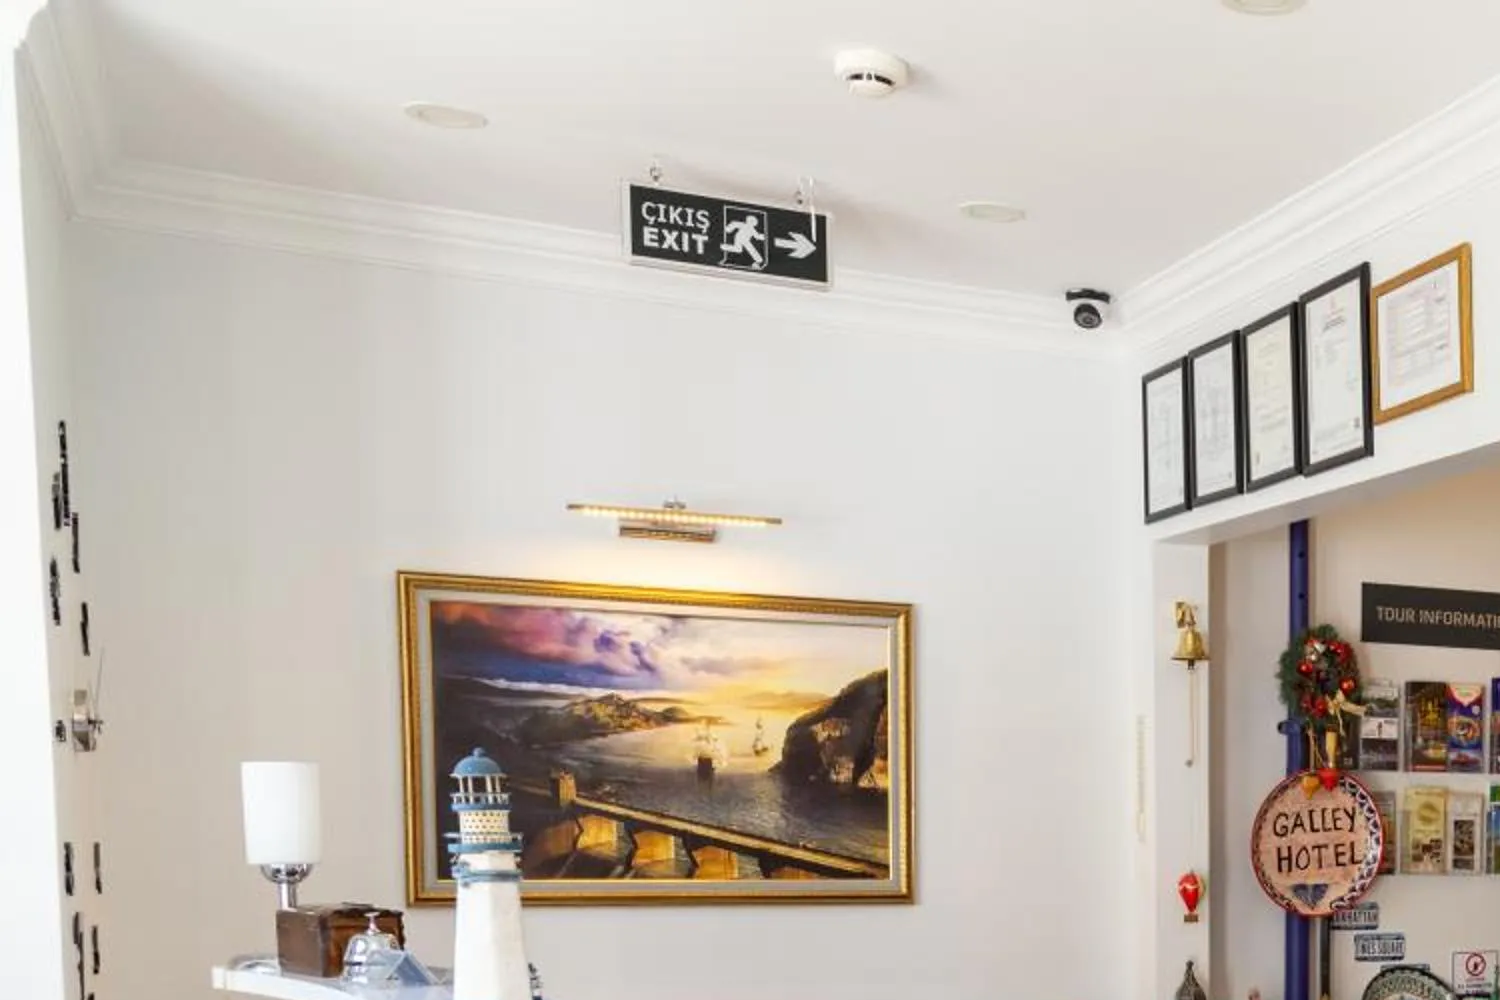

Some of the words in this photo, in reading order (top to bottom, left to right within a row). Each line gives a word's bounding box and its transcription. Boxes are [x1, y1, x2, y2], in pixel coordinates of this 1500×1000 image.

[641, 202, 710, 233] ÇIKIŞ
[643, 226, 709, 254] EXIT
[1376, 605, 1415, 624] TOUR
[1273, 807, 1357, 837] GALLEY
[1276, 841, 1363, 873] HOTEL
